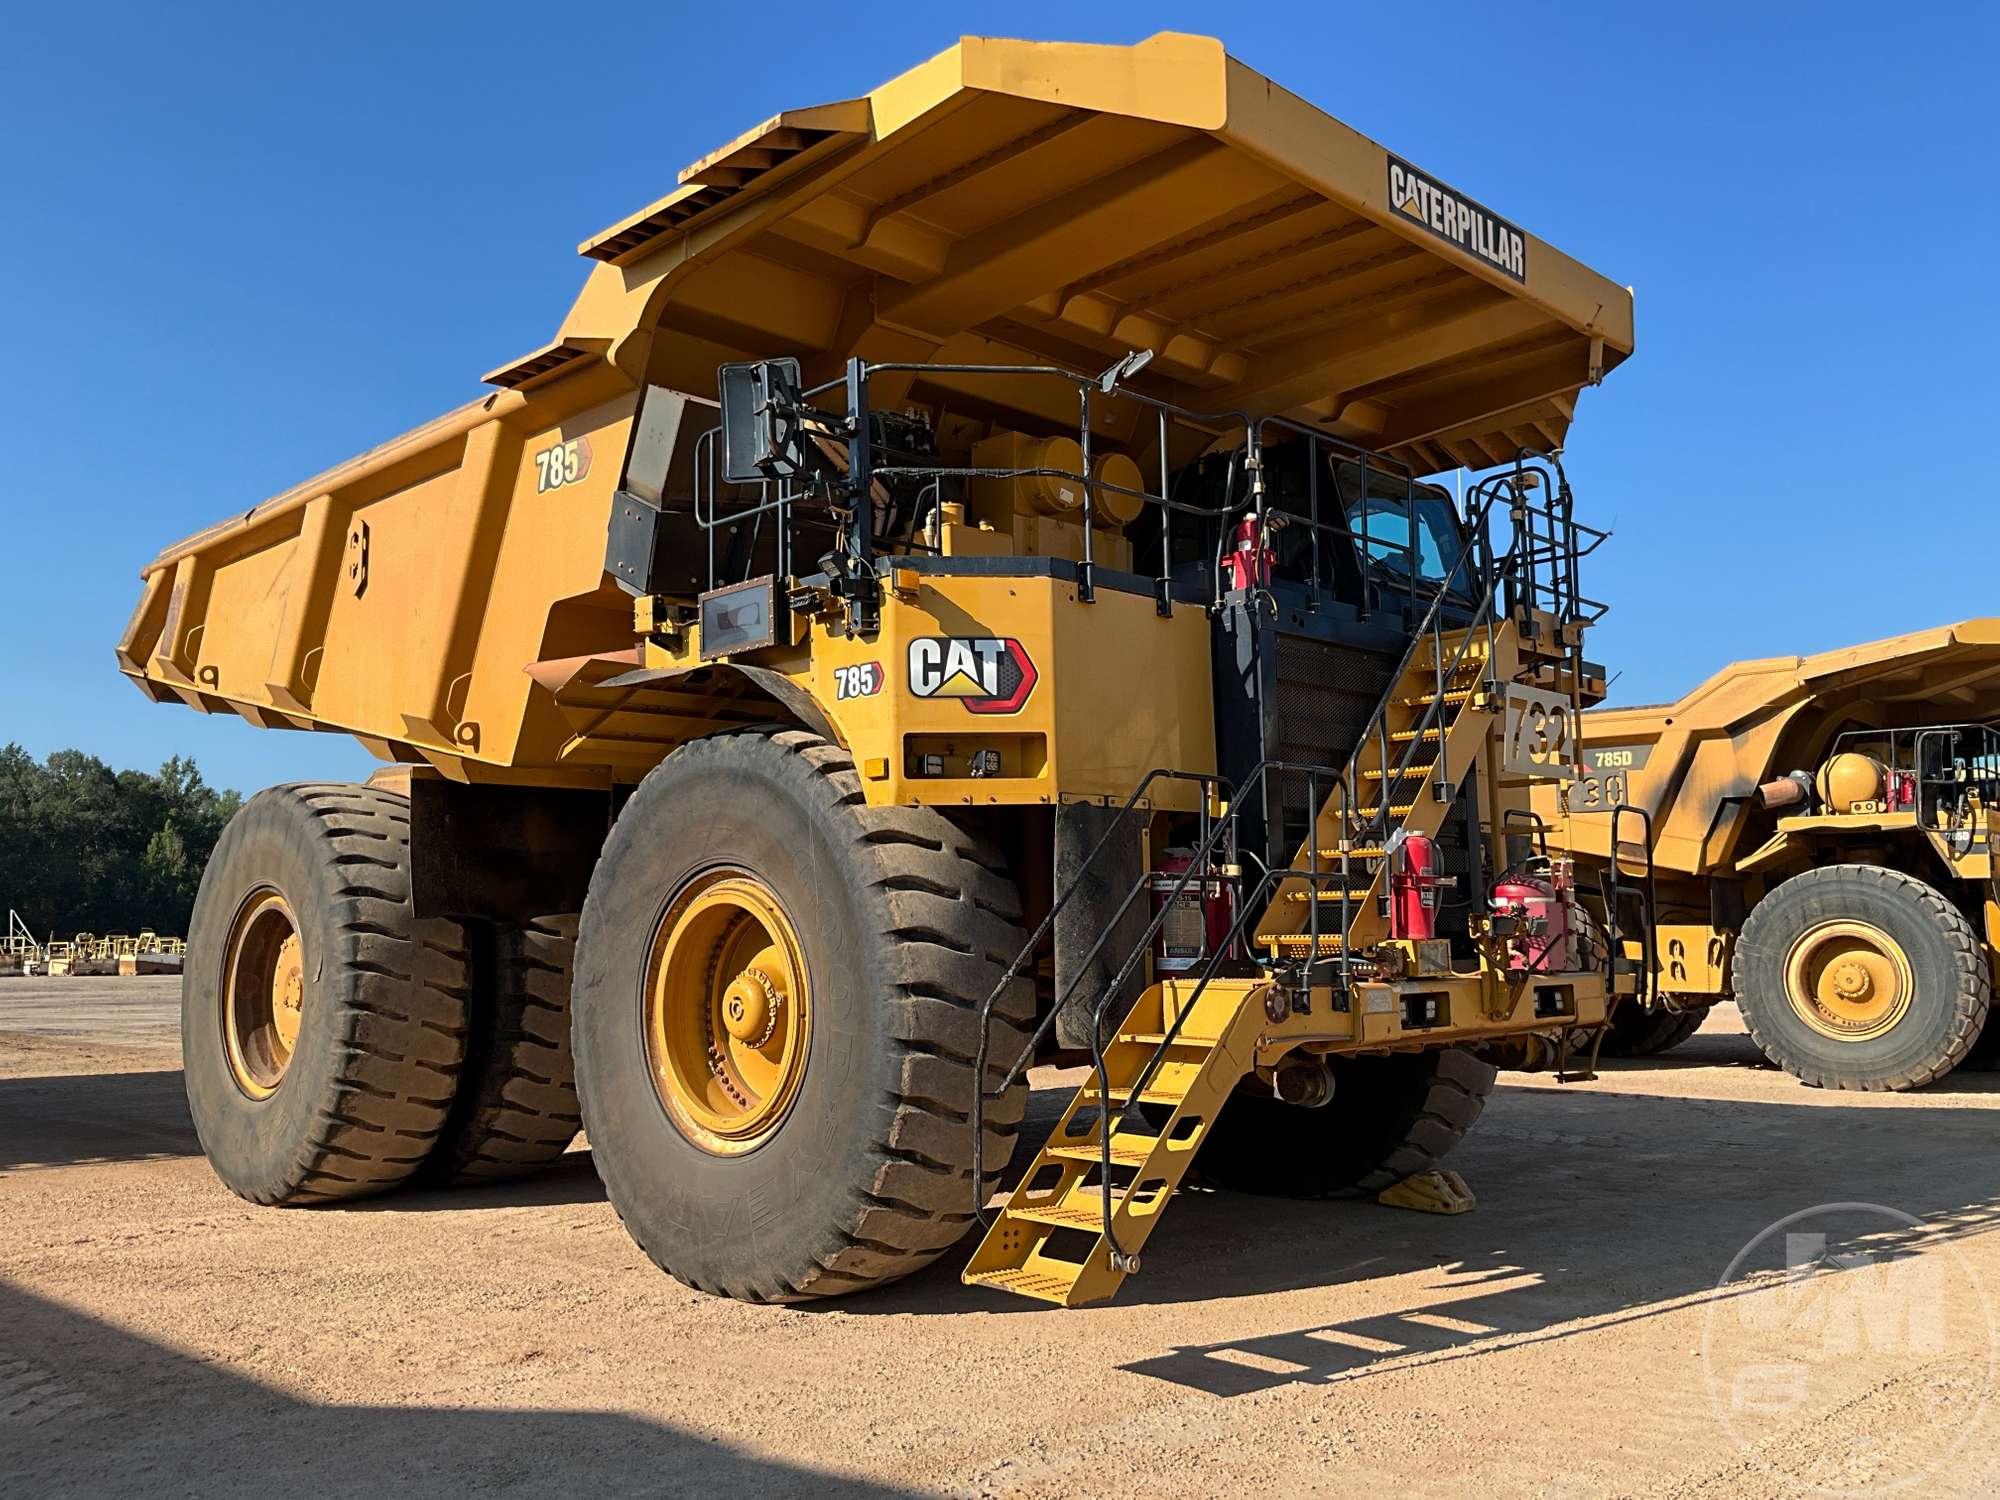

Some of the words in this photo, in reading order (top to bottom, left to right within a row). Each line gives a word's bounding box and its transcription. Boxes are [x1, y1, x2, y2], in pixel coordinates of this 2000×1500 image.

[1390, 164, 1523, 277] CATERPILLAR
[536, 440, 579, 492] 785
[834, 664, 874, 699] 785
[909, 638, 1005, 696] CAT
[1509, 697, 1571, 766] 732
[1595, 751, 1632, 767] 785D
